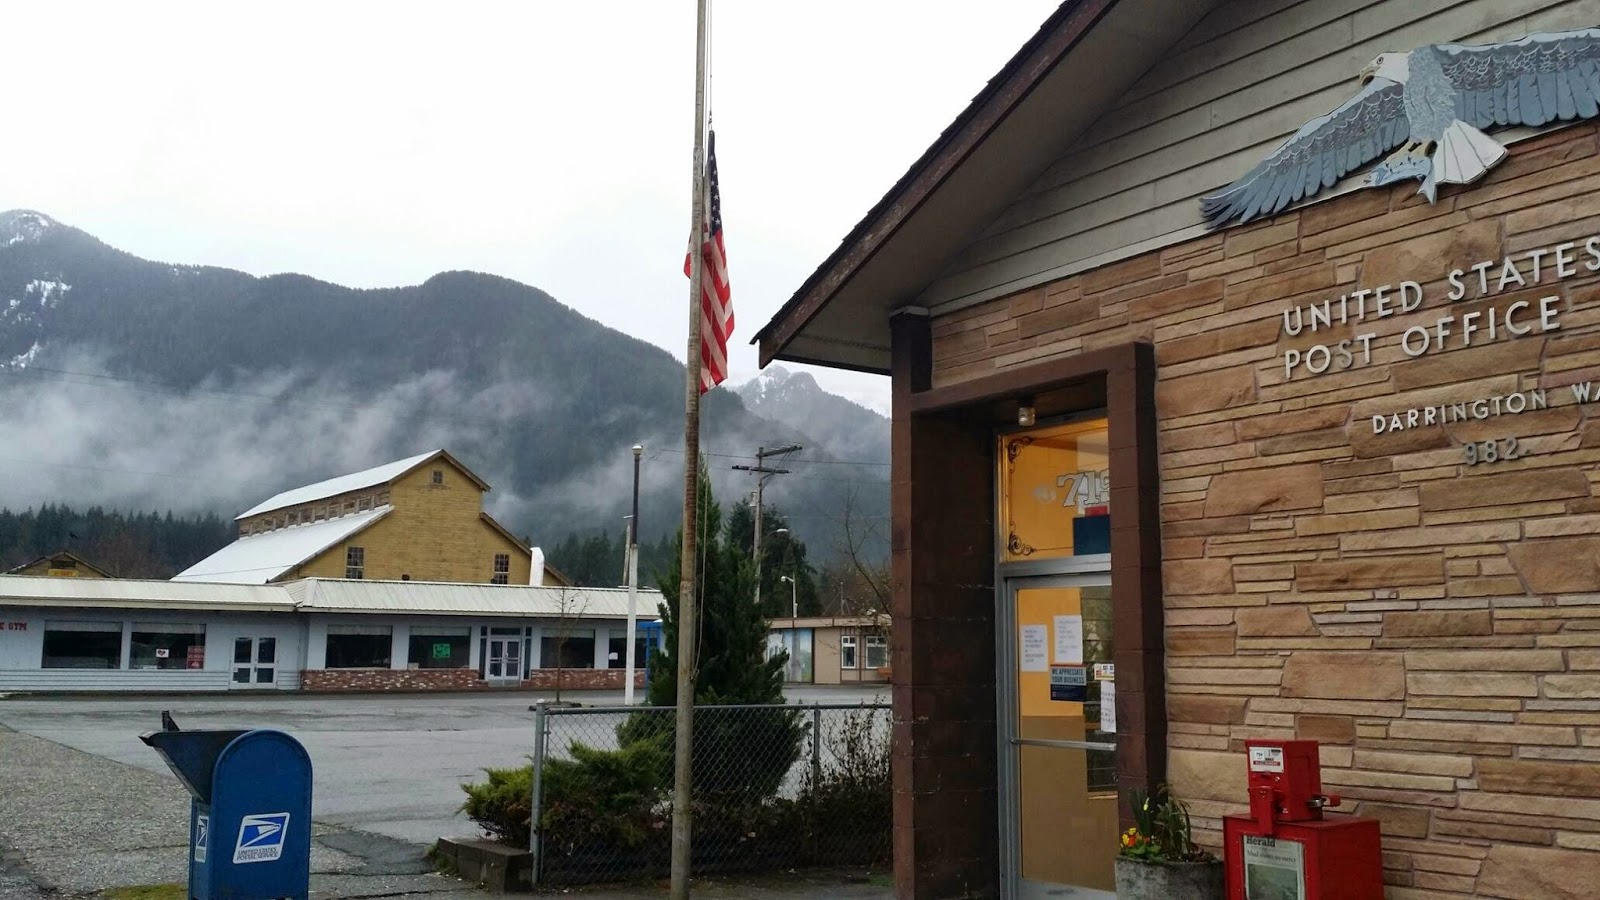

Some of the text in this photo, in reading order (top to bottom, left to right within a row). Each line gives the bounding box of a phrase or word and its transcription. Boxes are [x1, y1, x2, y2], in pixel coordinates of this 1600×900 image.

[1283, 236, 1600, 336] UNITED STATES
[1285, 296, 1561, 379] POST OFFICE
[1372, 389, 1547, 434] DARRINGTON
[1464, 437, 1519, 466] 982
[1052, 668, 1083, 676] WE APPRECIATE
[1064, 676, 1084, 684] BUSINESS
[1246, 836, 1275, 847] Herald
